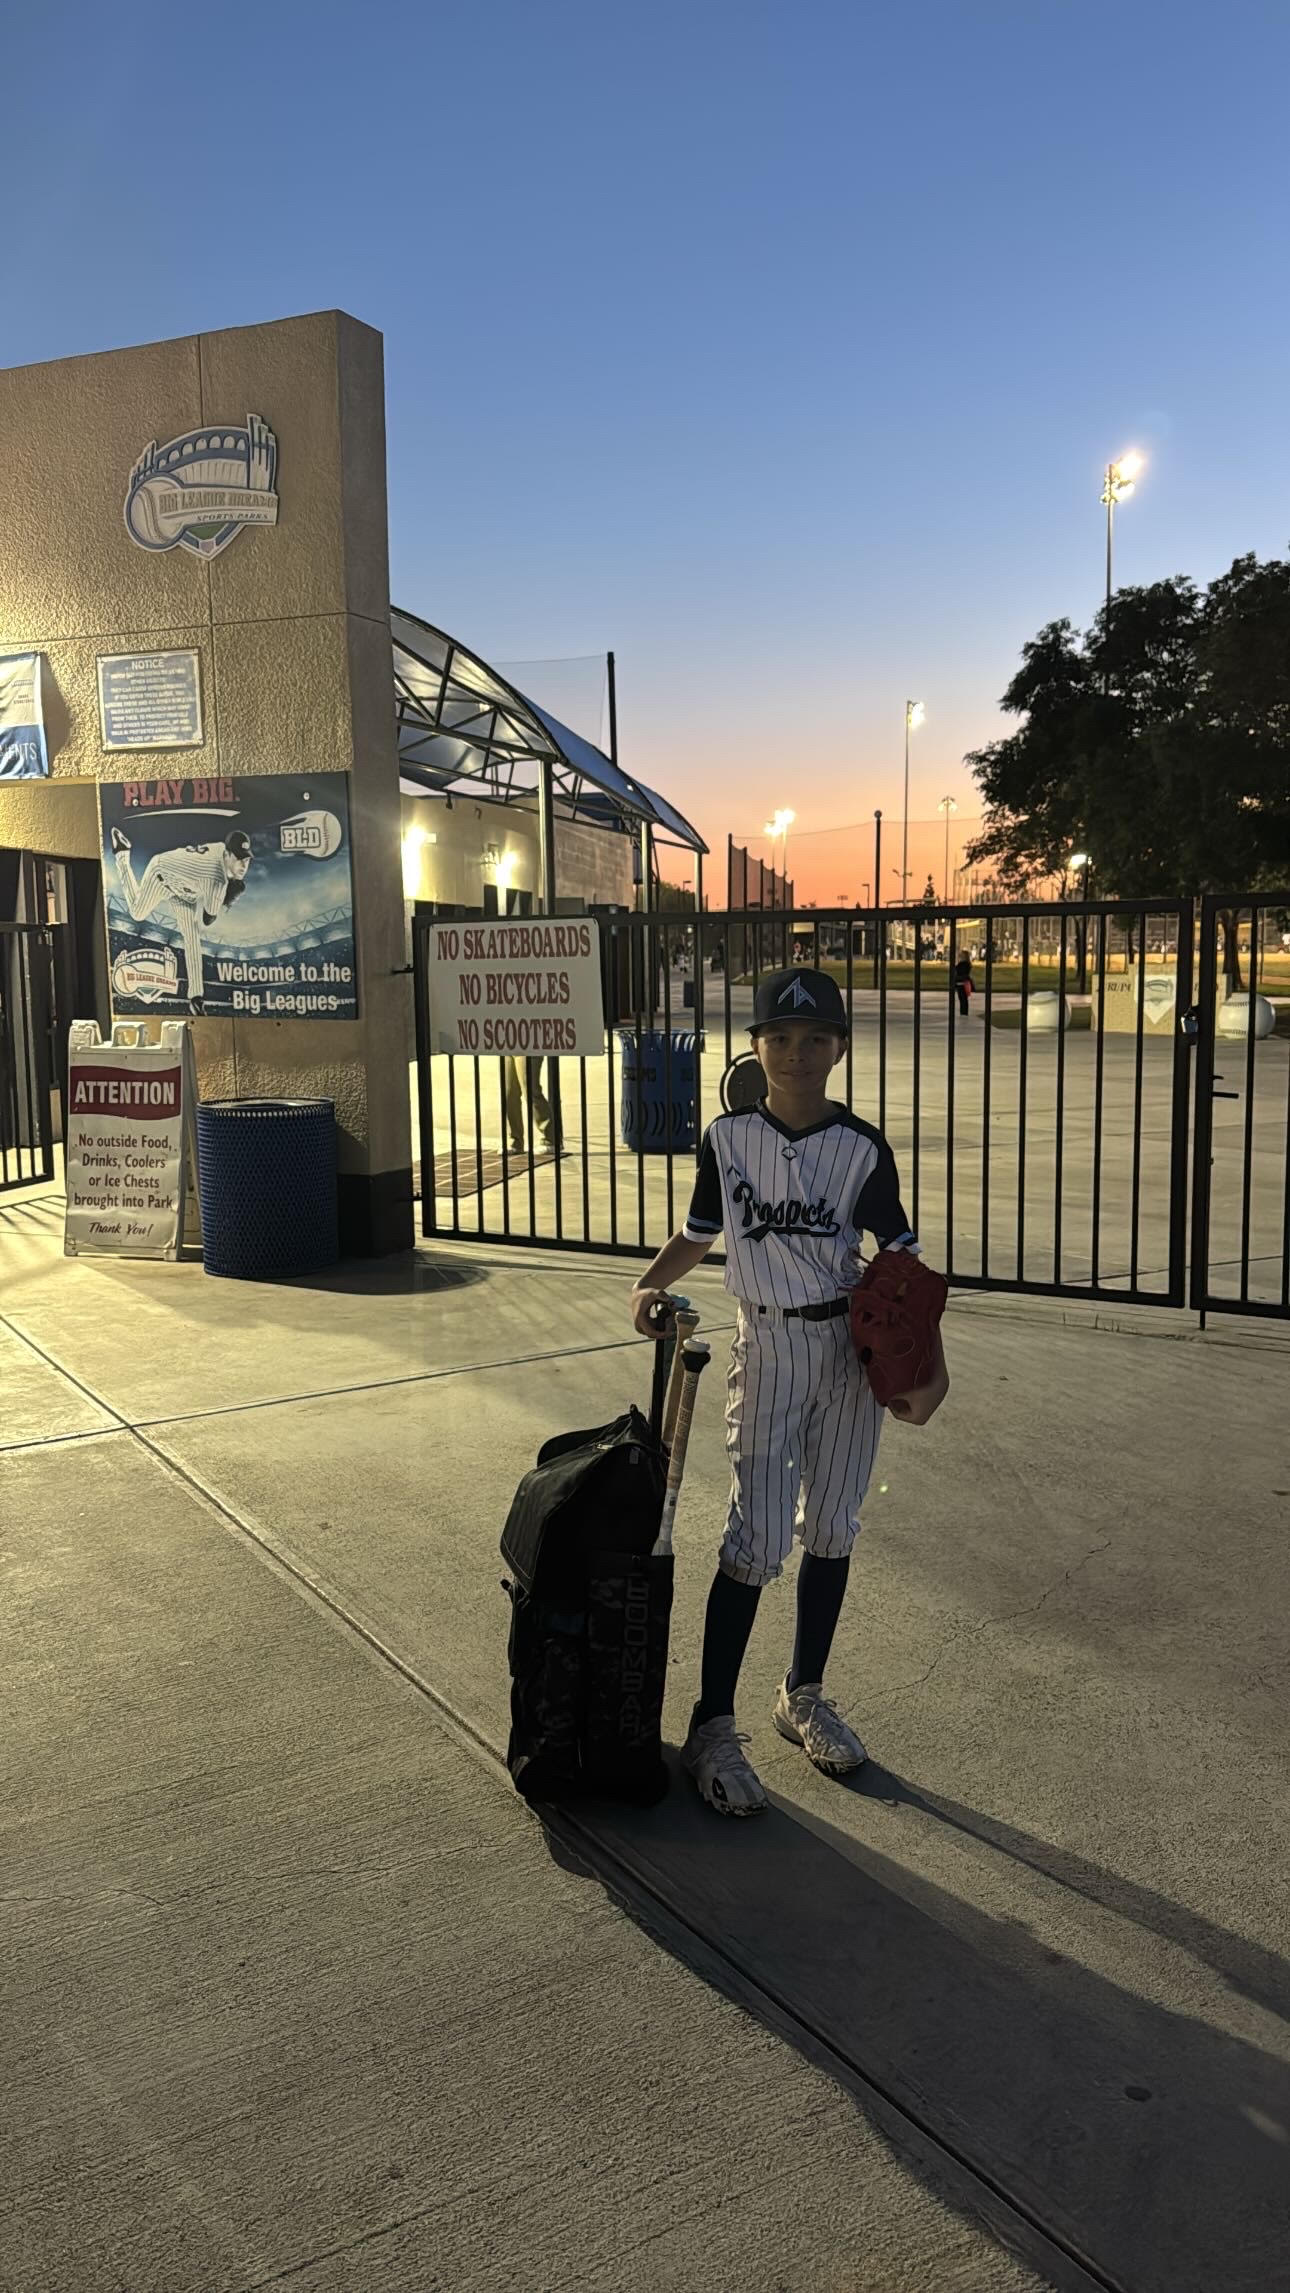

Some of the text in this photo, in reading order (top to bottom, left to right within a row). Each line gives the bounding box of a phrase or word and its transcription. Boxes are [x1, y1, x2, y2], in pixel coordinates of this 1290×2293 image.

[131, 658, 165, 670] NOTICE
[123, 778, 240, 807] PLAY BIG.
[282, 828, 320, 848] BLD
[437, 924, 591, 960] NO SKATEBOARDS
[216, 962, 351, 982] Welcome to the
[459, 972, 570, 1005] NO BICYCLES
[232, 990, 338, 1015] Big Leagues
[457, 1017, 577, 1051] NO SCOOTERS
[74, 1080, 176, 1105] ATTENTION
[79, 1133, 172, 1151] No outside Food,
[82, 1153, 166, 1169] Drinks, Coolers
[88, 1174, 160, 1188] or Ice Chests
[74, 1193, 172, 1210] brought into Park
[733, 1180, 840, 1237] Prospects
[89, 1222, 154, 1237] Thank You!
[618, 1577, 649, 1737] BOOMBAH
